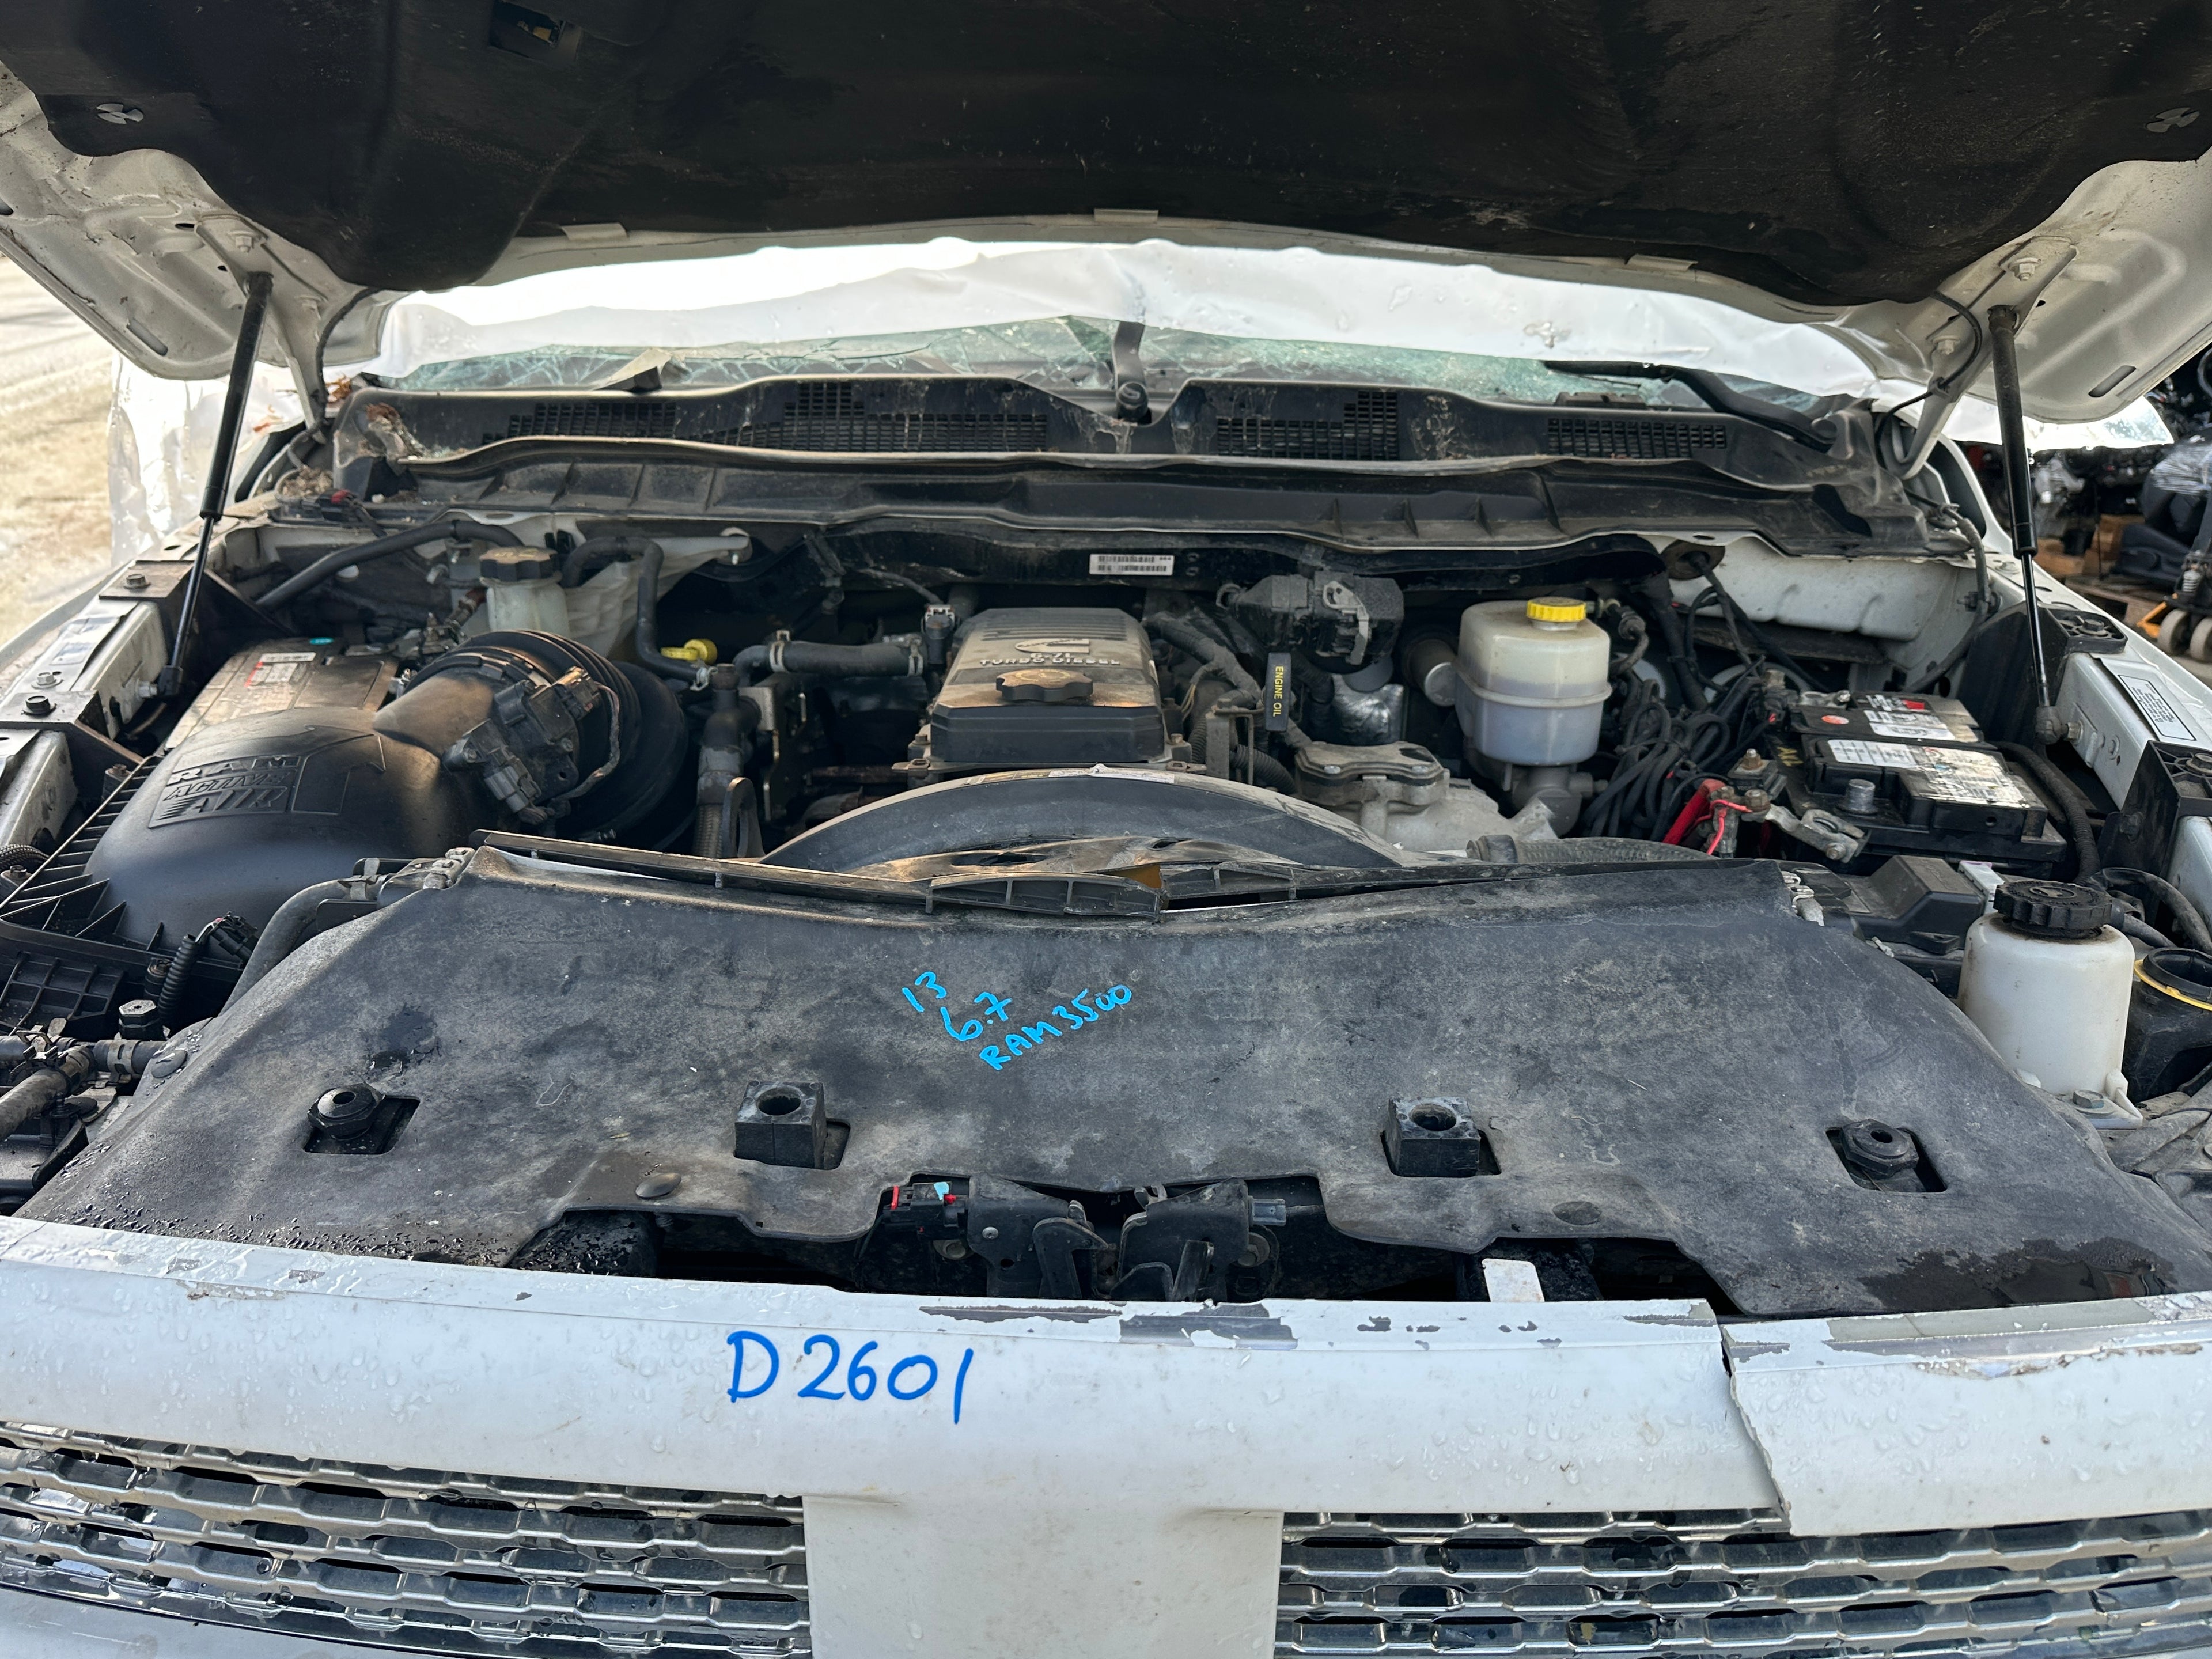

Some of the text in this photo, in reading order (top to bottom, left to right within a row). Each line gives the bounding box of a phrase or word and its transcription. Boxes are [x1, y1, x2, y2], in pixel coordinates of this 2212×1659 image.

[1272, 666, 1283, 717] ENGINE OIL
[162, 770, 296, 801] ACTIVE
[165, 755, 301, 786] RAM
[158, 786, 287, 820] AIR
[902, 970, 948, 1013] 13
[940, 991, 1012, 1043] 6.7
